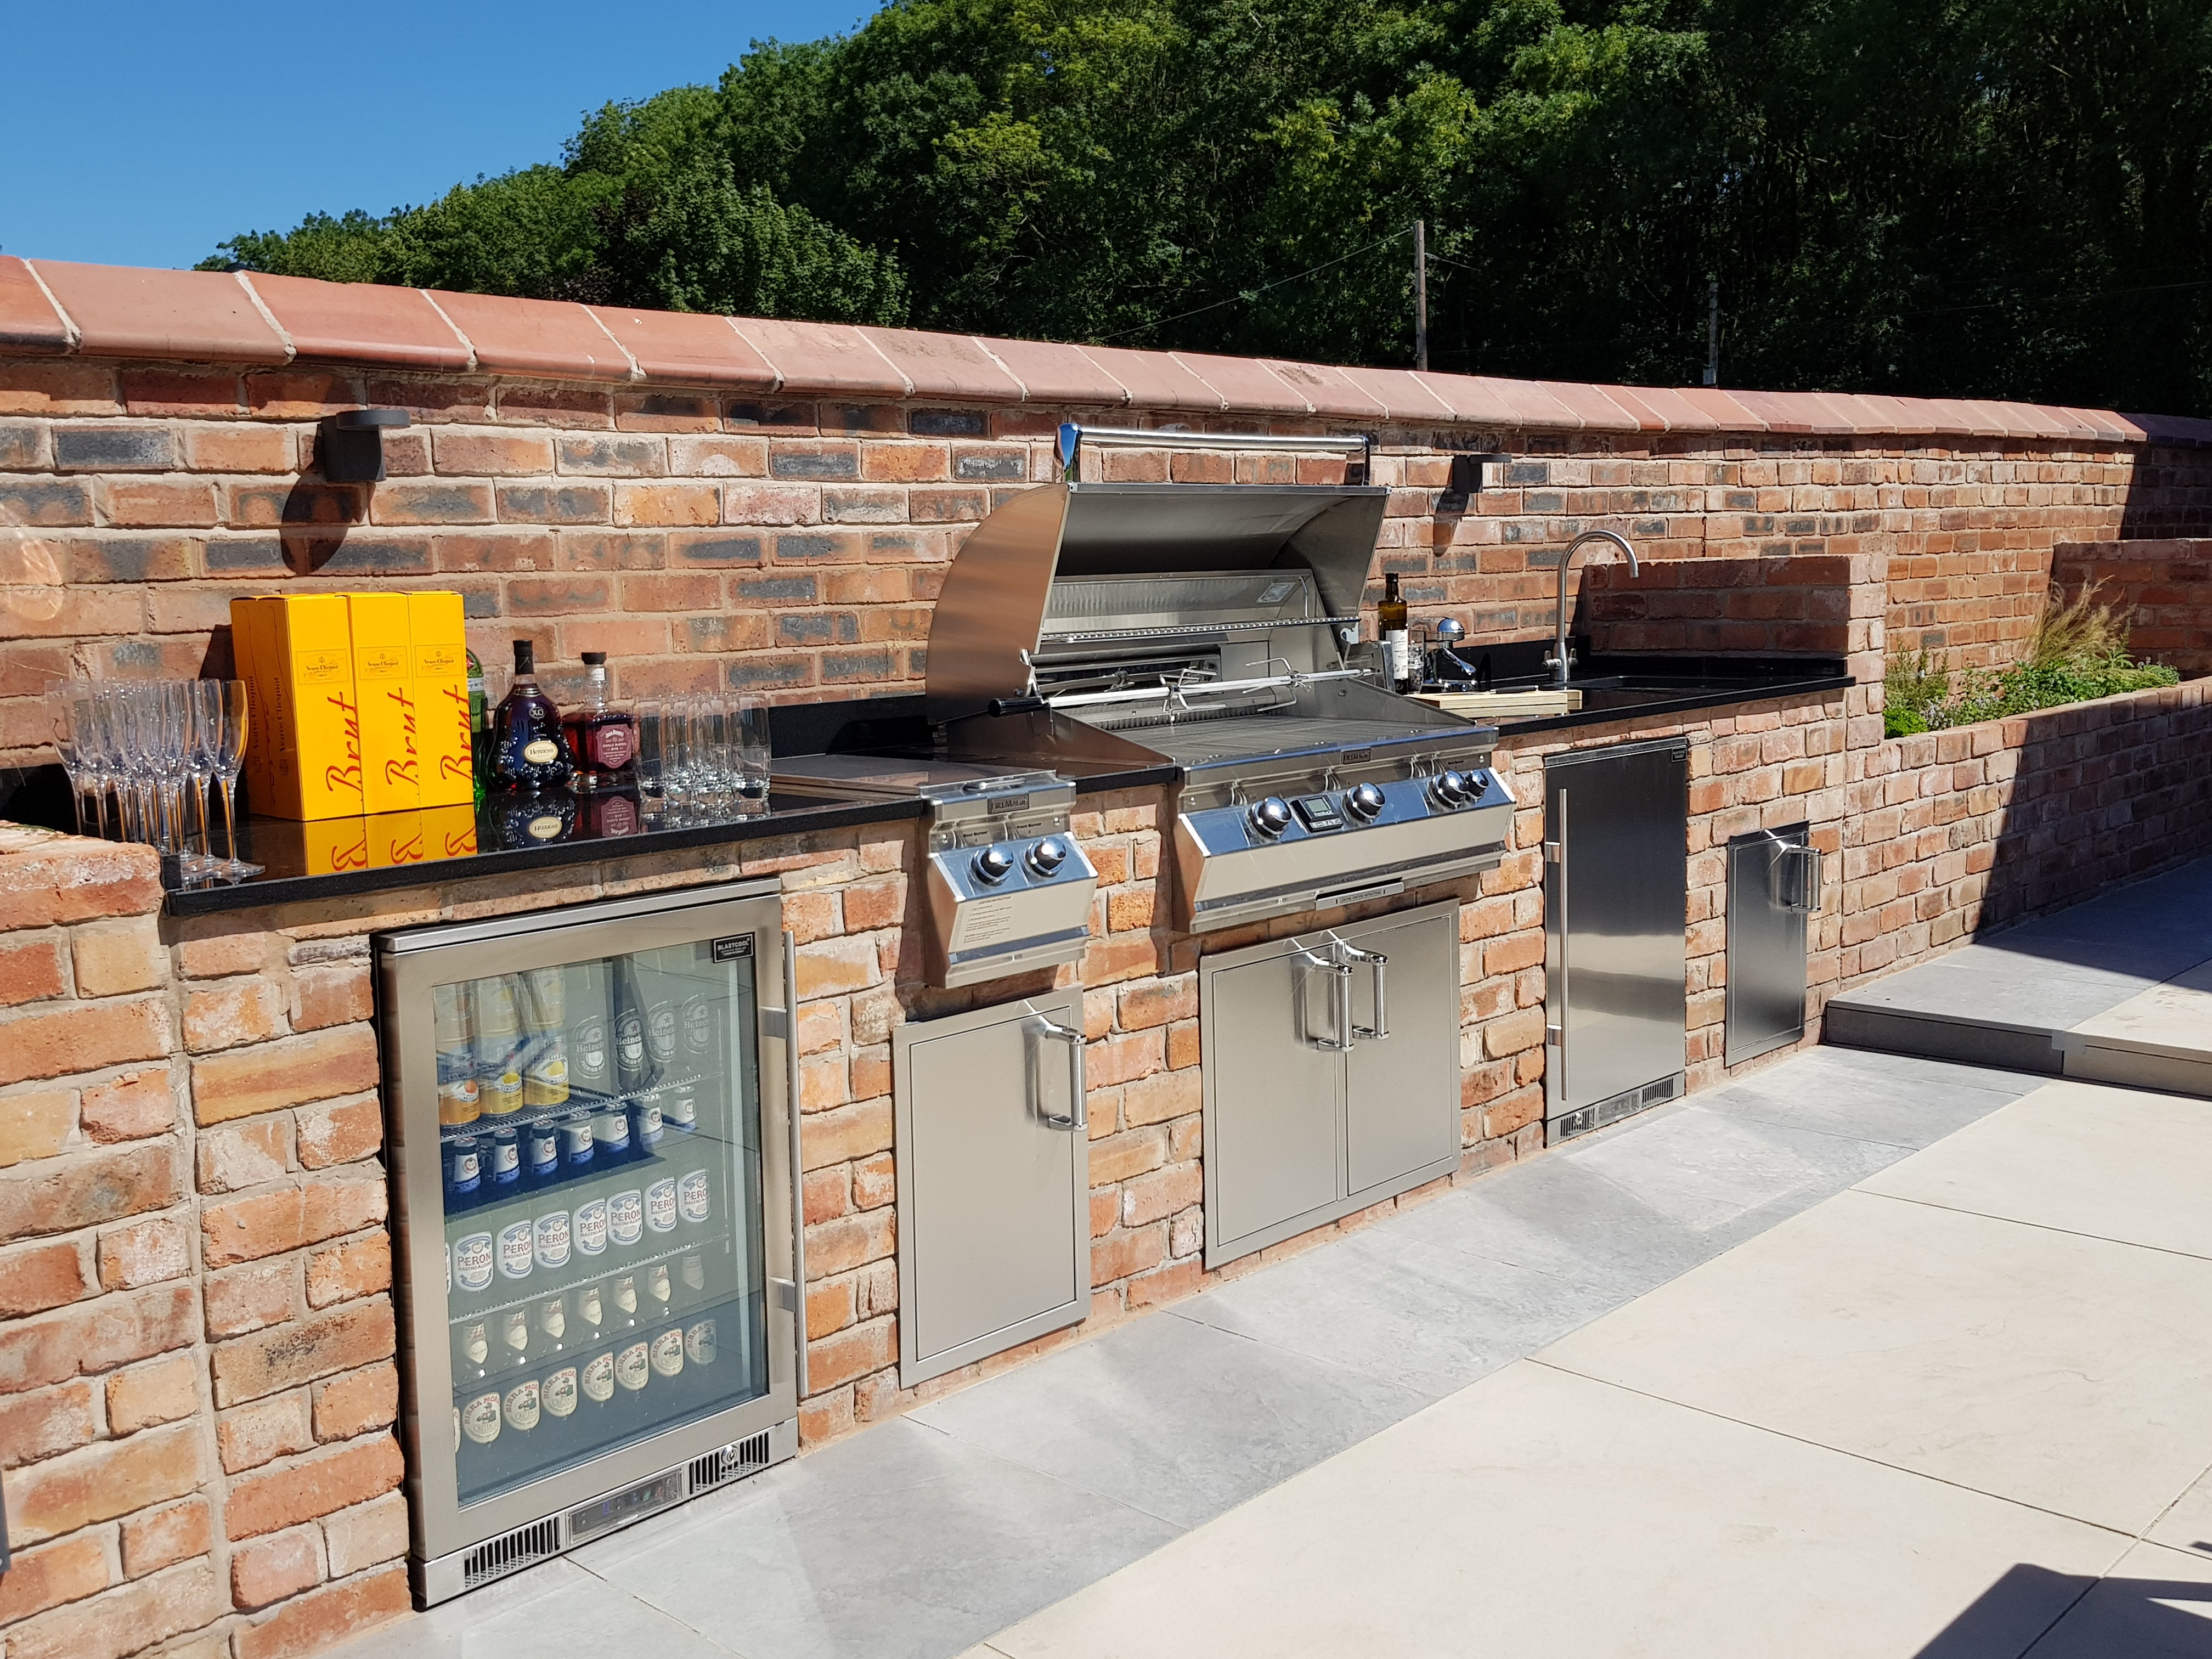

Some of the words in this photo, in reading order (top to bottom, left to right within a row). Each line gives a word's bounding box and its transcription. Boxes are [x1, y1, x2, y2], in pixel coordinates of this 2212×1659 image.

[326, 691, 363, 792] Brut
[386, 687, 419, 786] Brut
[440, 684, 472, 780] Brut
[718, 940, 749, 950] BLASTCOOL
[684, 1188, 707, 1200] PERO
[611, 1209, 641, 1221] PERON
[539, 1231, 569, 1244] PERON
[458, 1251, 491, 1266] PERON
[653, 1336, 669, 1358] BIRRA
[585, 1361, 602, 1384] BIRRA
[618, 1350, 634, 1373] BIRRA
[543, 1375, 560, 1399] BIRRA
[464, 1401, 482, 1424] BIRRA
[506, 1389, 524, 1413] BIRRA
